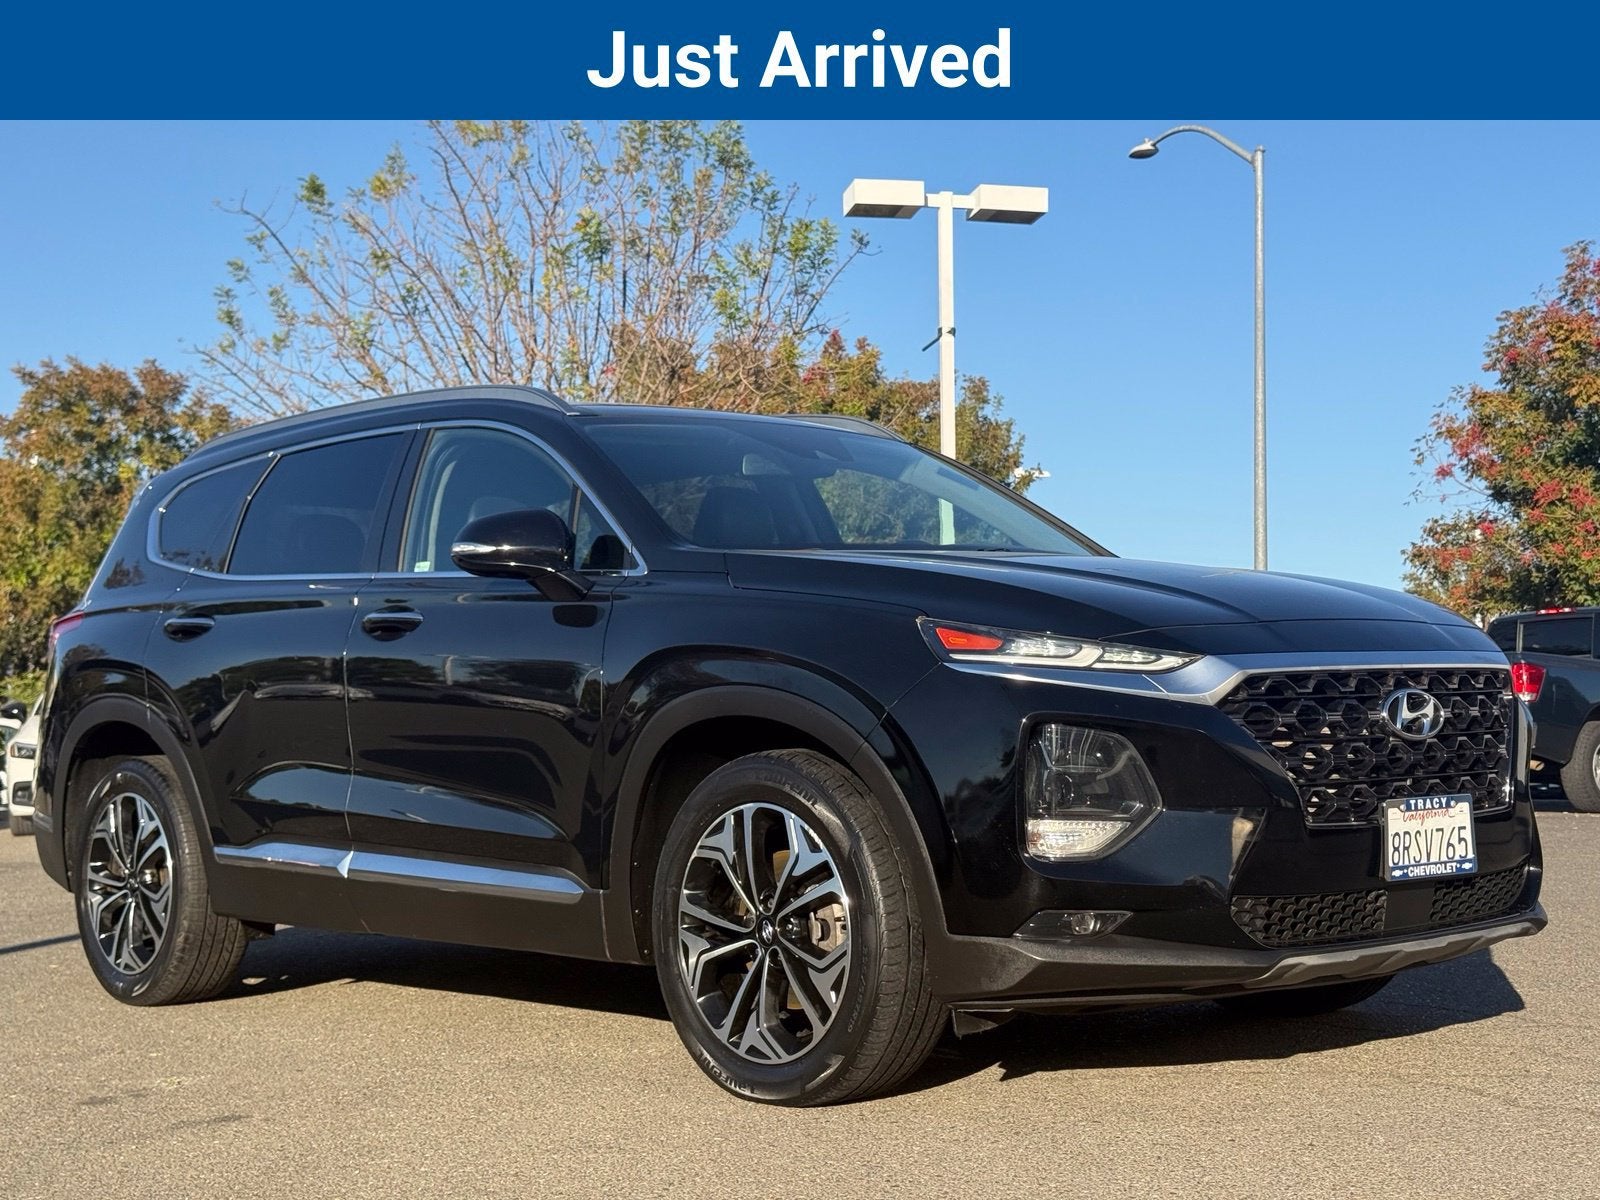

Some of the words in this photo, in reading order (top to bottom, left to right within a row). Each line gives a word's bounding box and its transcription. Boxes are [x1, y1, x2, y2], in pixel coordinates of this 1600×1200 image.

[1409, 797, 1448, 810] TRACY
[1391, 826, 1468, 866] 8RSV765
[1408, 862, 1457, 877] CHEVROLET
